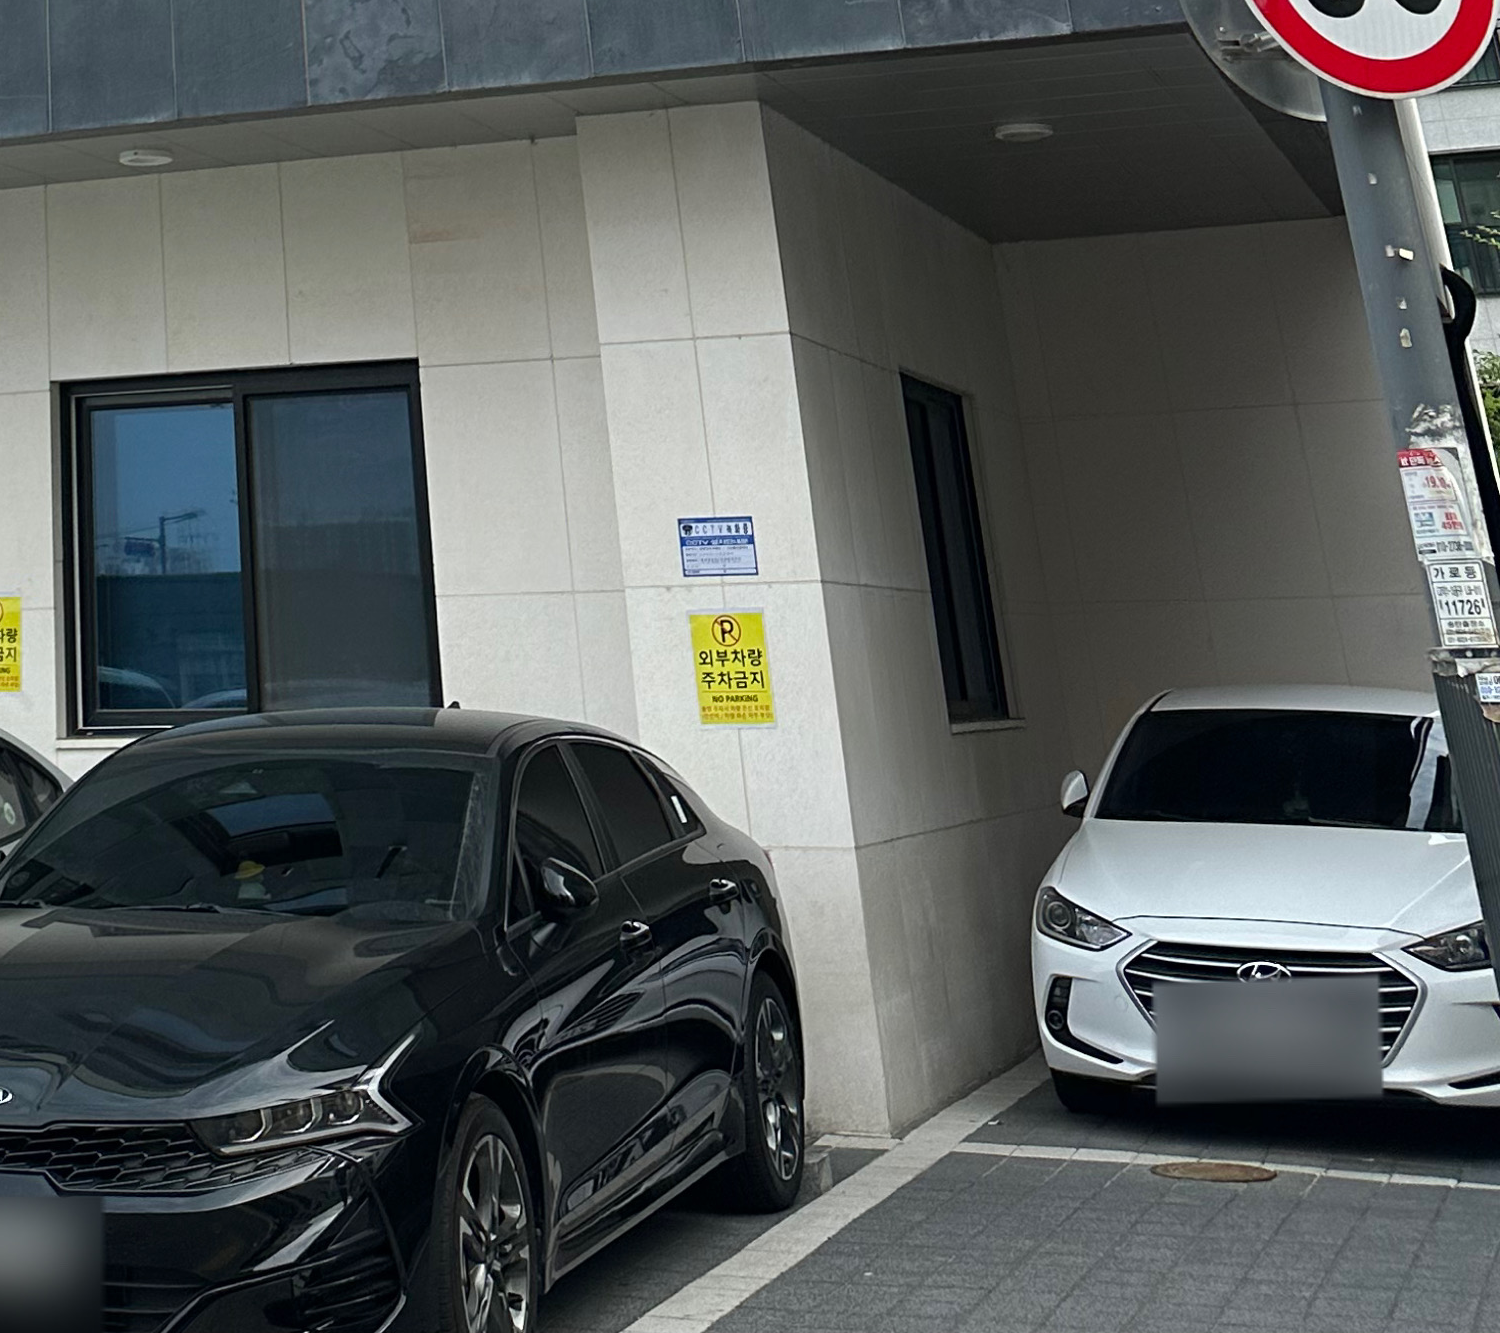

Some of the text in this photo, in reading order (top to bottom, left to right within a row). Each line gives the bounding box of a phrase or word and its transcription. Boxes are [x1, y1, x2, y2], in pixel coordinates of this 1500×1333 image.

[1445, 599, 1482, 616] 11726
[698, 648, 763, 667] 외부차량
[701, 670, 765, 689] 주차금지
[712, 694, 759, 703] NO PARKING
